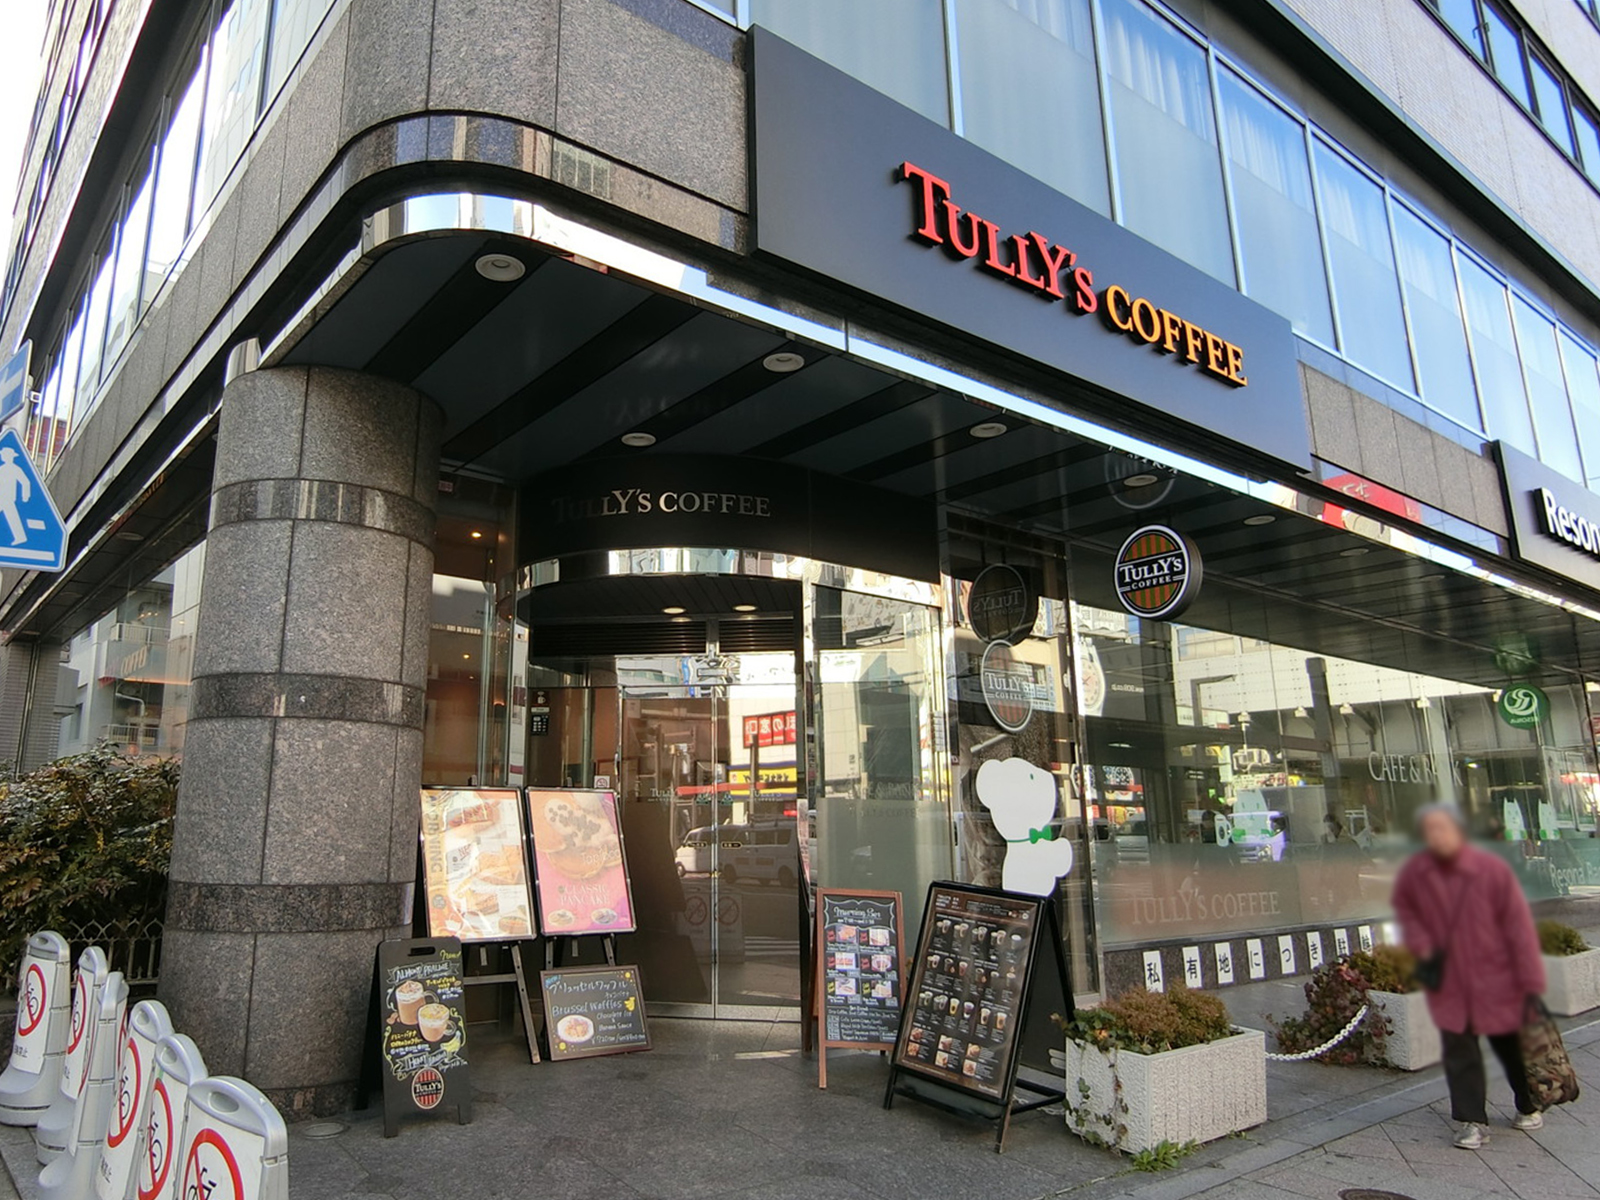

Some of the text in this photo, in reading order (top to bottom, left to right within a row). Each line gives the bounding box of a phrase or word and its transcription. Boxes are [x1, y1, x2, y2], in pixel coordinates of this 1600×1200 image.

[901, 161, 1248, 387] TULLY'S COFFEE
[658, 491, 771, 518] COFFEE
[1119, 556, 1183, 583] TULLY'S
[1131, 575, 1172, 590] COFFEE
[984, 671, 1030, 693] TULLY'S
[1368, 751, 1463, 787] CAFE & BK
[1550, 863, 1585, 889] Resona
[1132, 887, 1282, 925] TULLY'S COFFEE
[551, 999, 623, 1017] Brussel Waffles
[414, 1082, 442, 1093] TULLY'S
